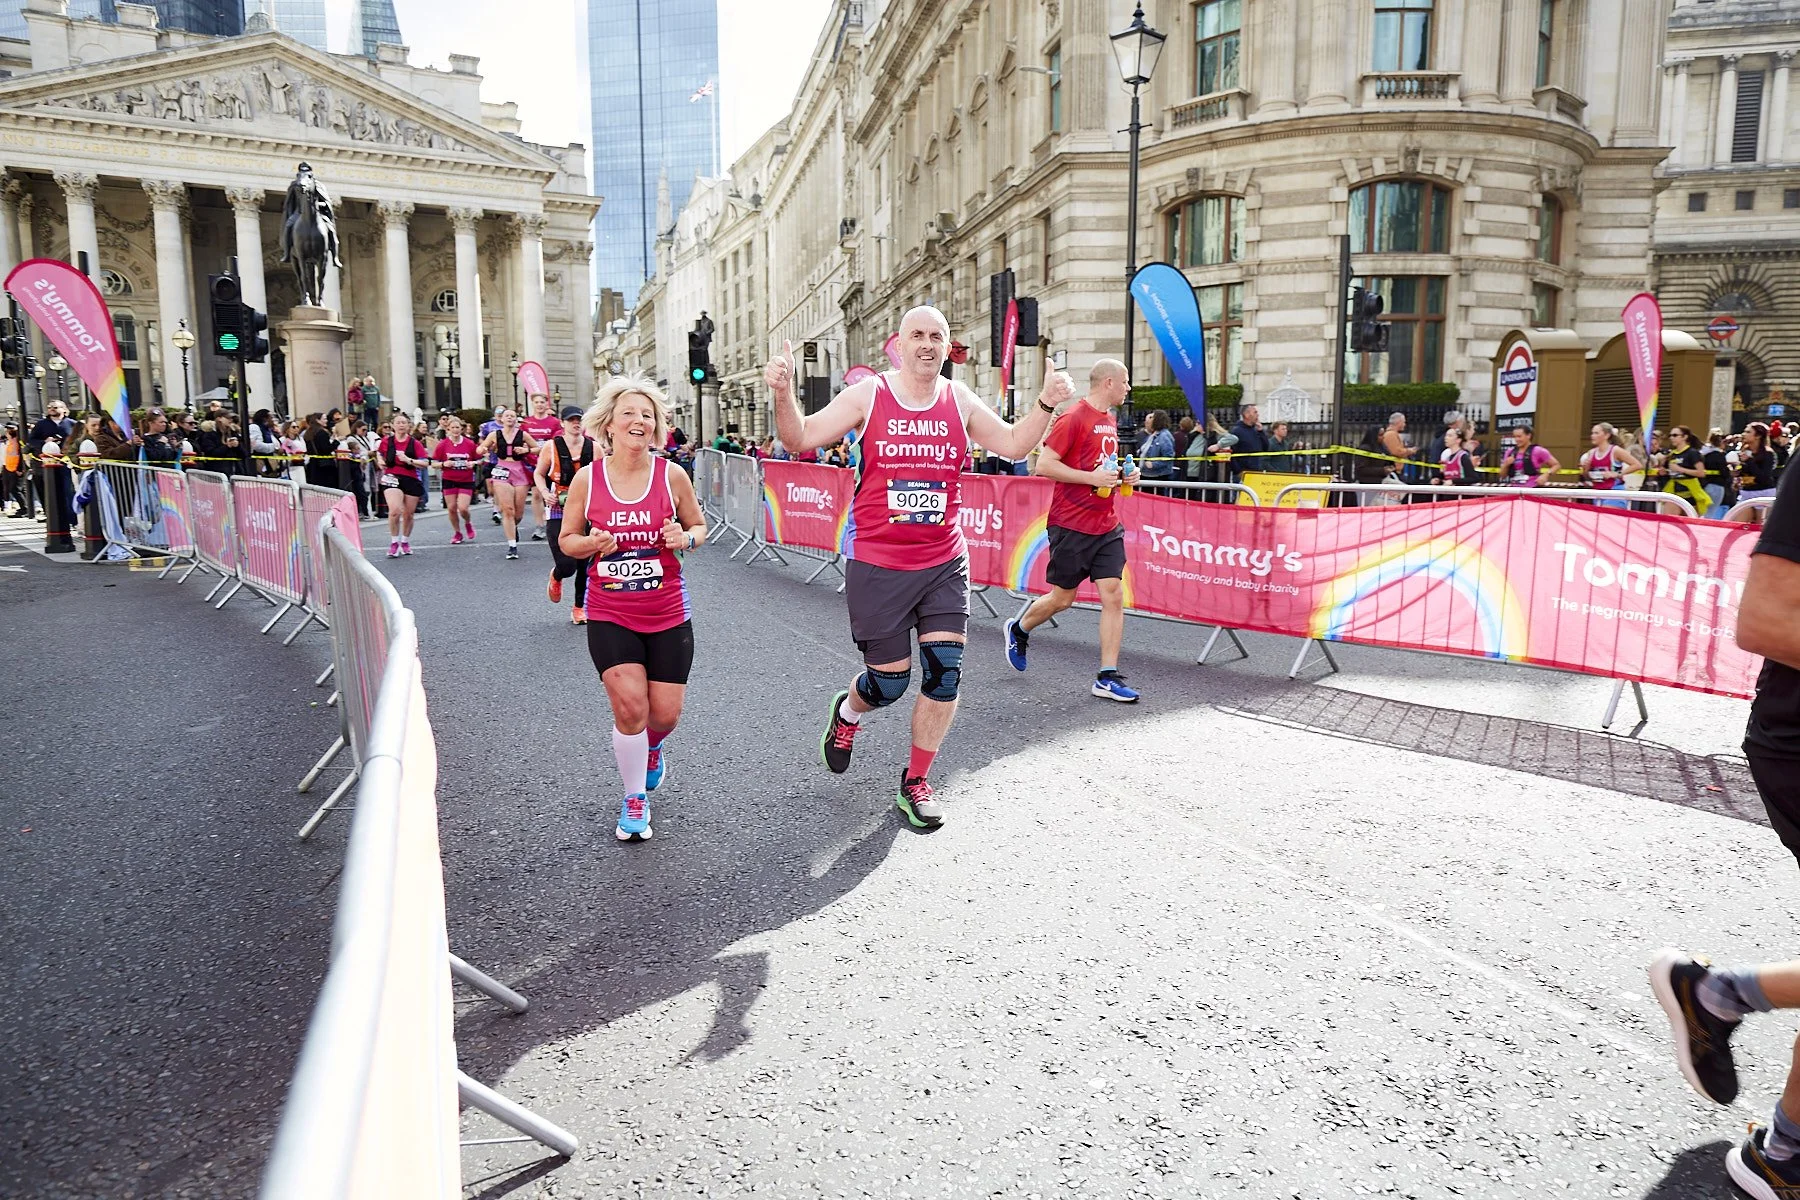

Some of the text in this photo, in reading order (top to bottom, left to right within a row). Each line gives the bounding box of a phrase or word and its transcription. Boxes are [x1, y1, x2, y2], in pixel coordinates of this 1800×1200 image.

[887, 419, 949, 437] SEAMUS
[875, 440, 958, 462] Tommy's
[786, 482, 833, 510] Tommy's
[896, 492, 939, 509] 9026
[606, 511, 651, 527] JEAN
[957, 503, 1003, 535] my's
[1142, 524, 1303, 577] Tommy's
[607, 562, 654, 577] 9025
[1144, 561, 1300, 596] The pregnancy and baby charity
[1554, 542, 1745, 617] Tomm
[1551, 596, 1578, 611] The
[1582, 603, 1664, 627] pregnancy
[1699, 623, 1736, 639] bab
